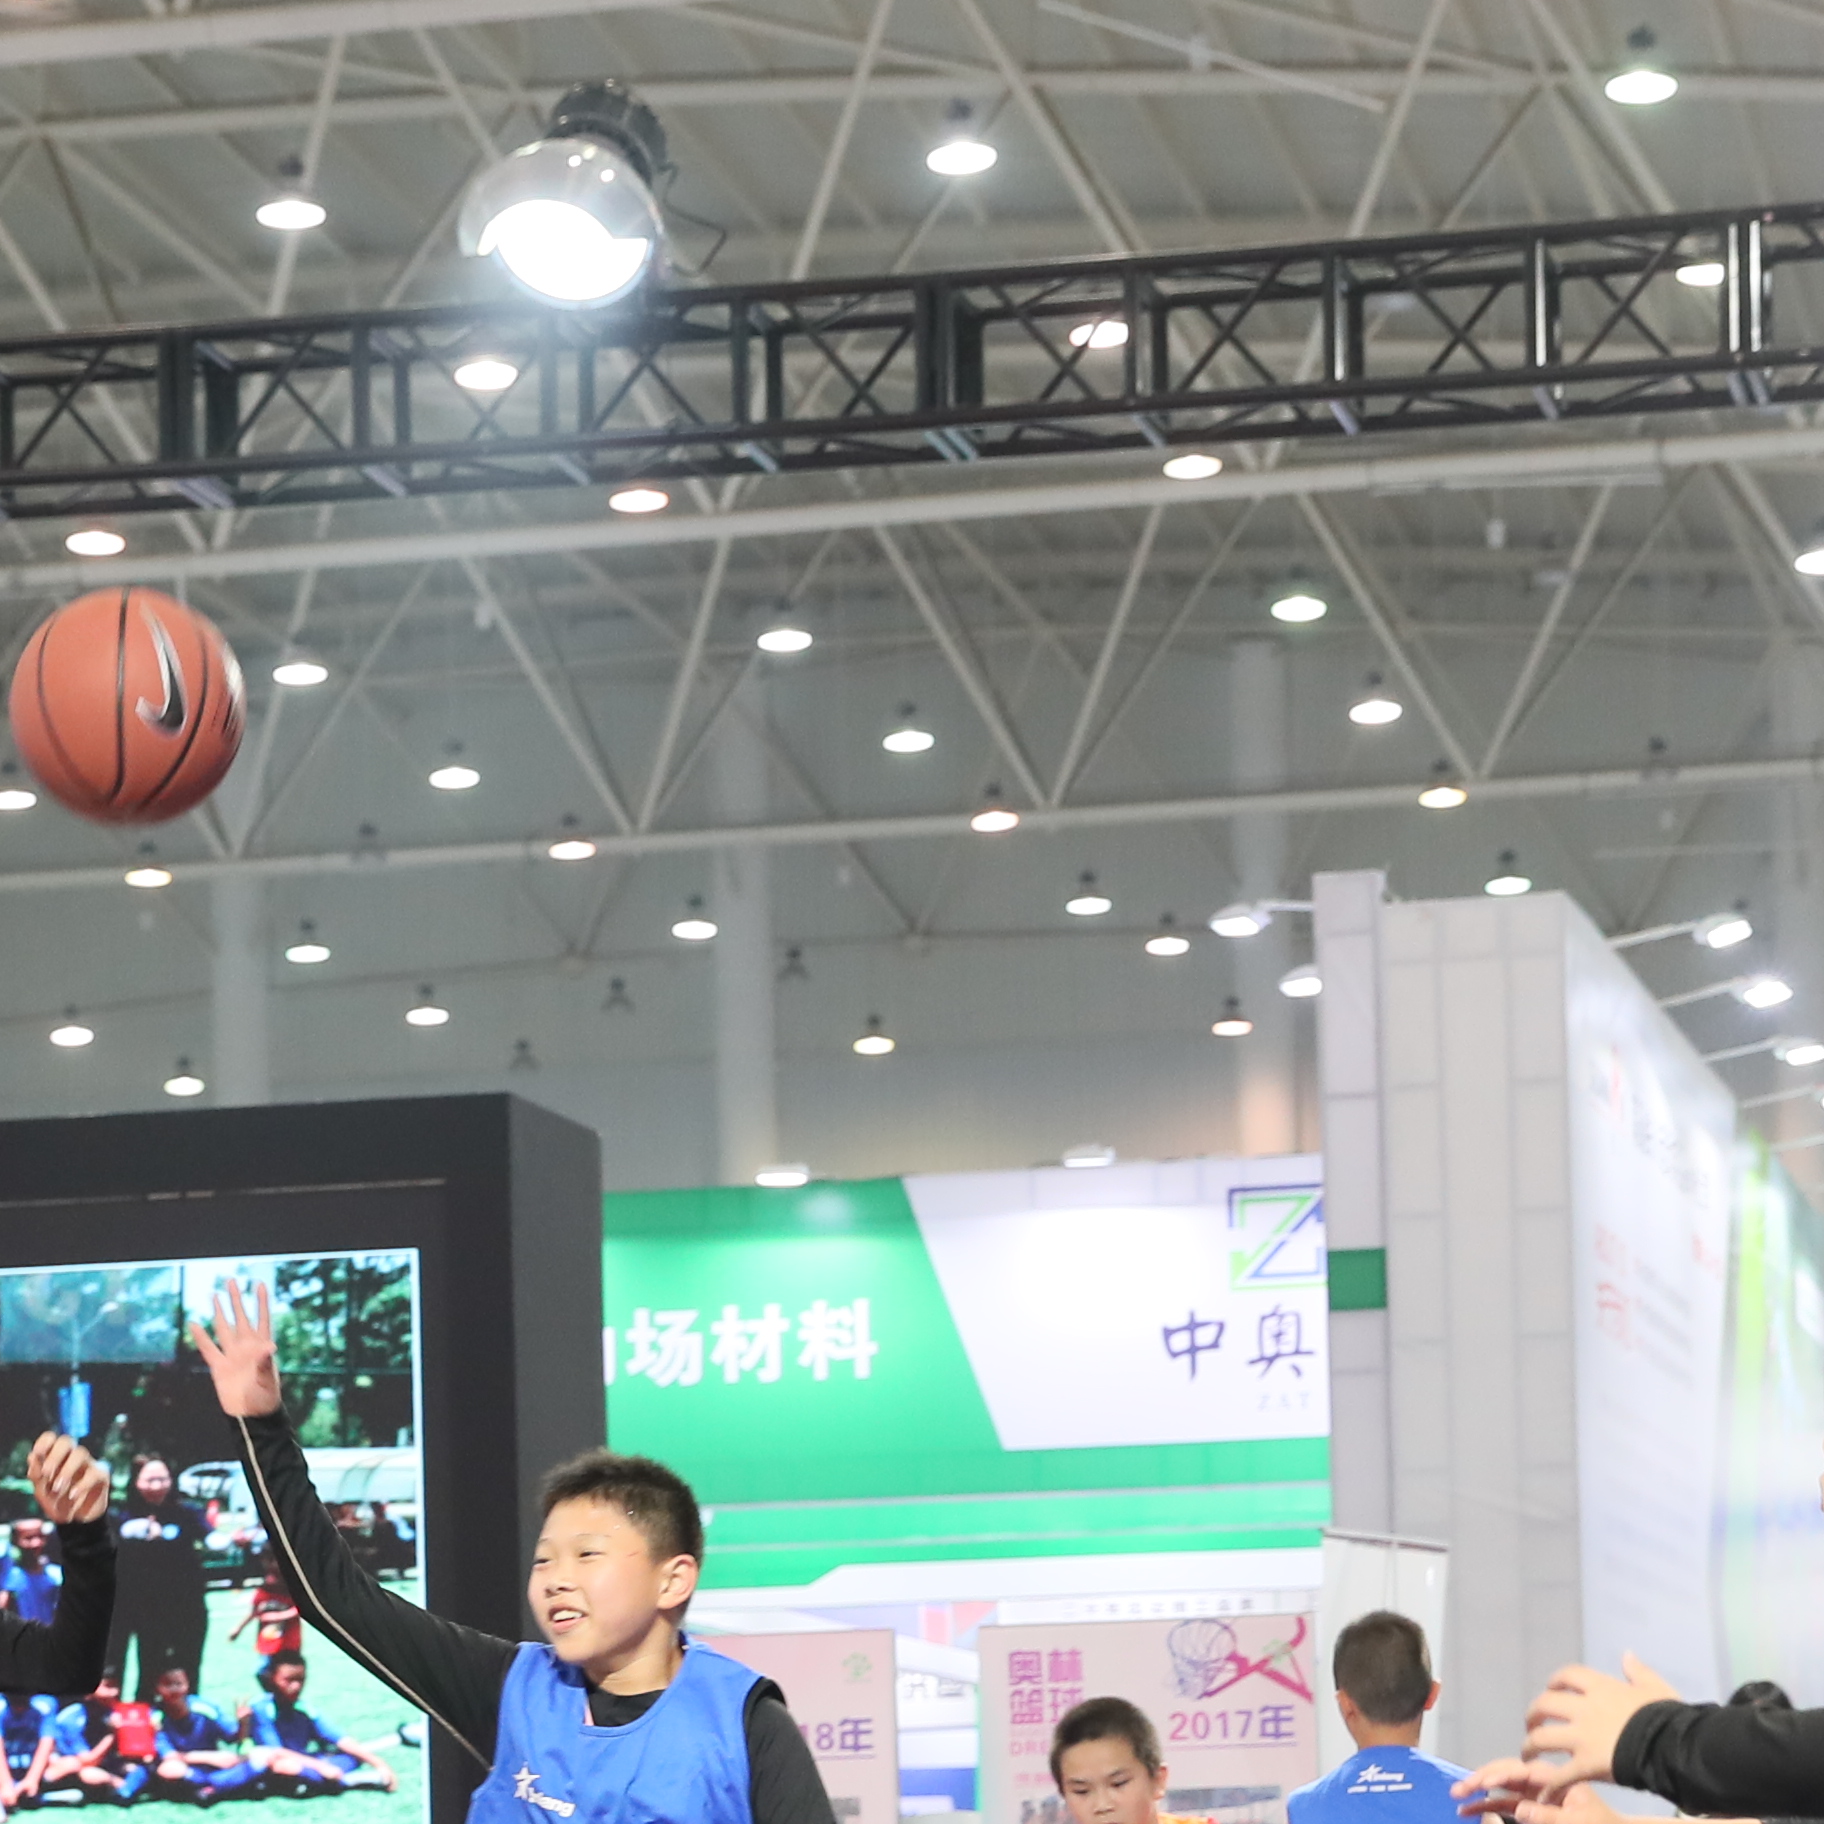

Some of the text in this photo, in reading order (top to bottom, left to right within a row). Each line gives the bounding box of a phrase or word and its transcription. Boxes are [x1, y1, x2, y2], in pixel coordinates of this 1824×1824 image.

[1163, 1303, 1314, 1381] 中奥
[1008, 1649, 1083, 1686] 奥林
[1169, 1704, 1296, 1742] 2017年
